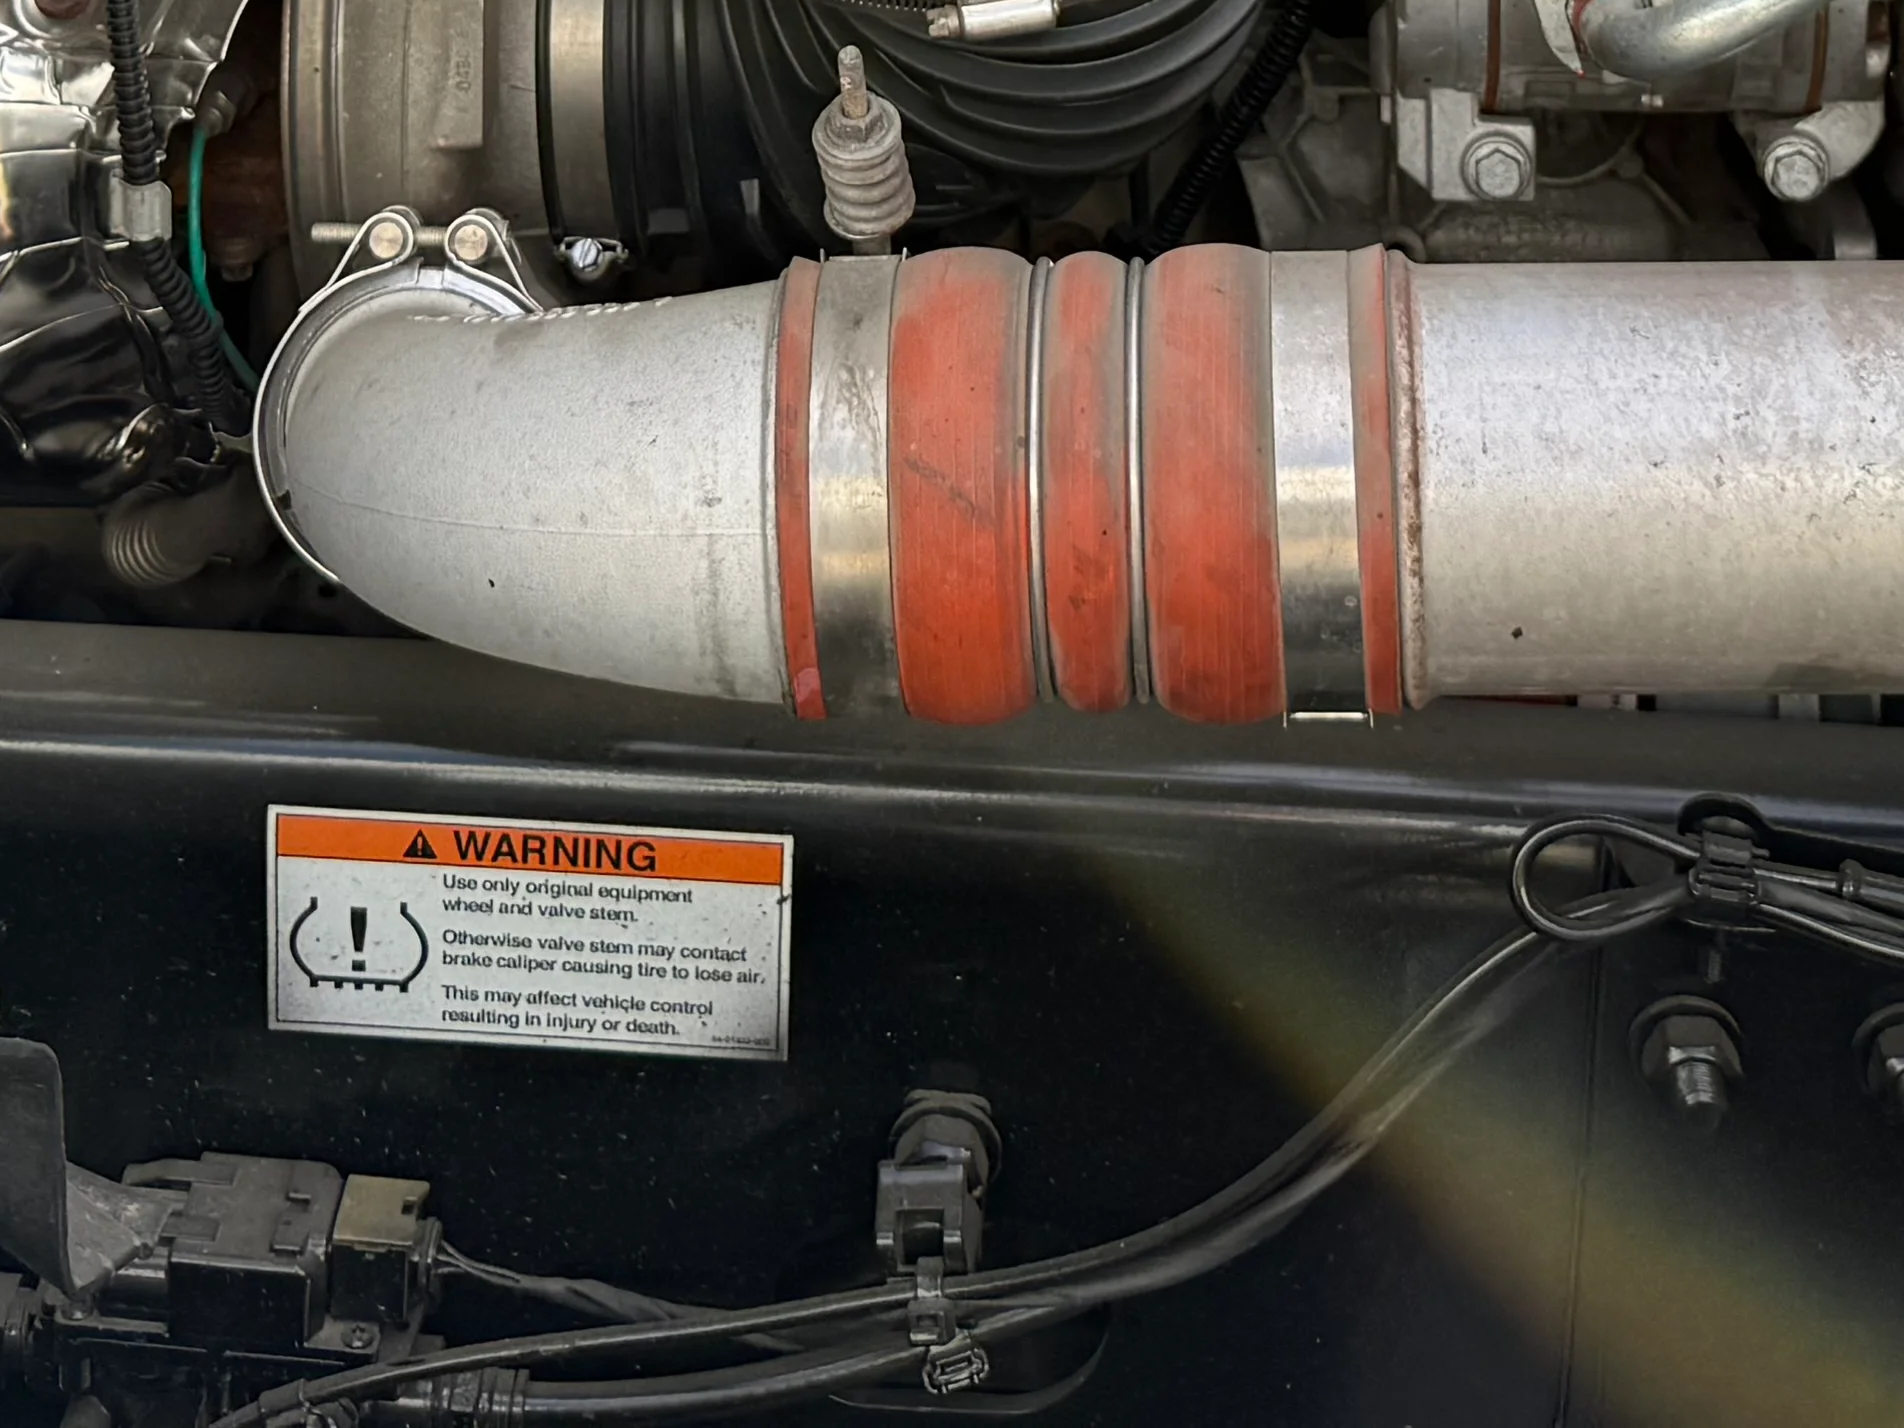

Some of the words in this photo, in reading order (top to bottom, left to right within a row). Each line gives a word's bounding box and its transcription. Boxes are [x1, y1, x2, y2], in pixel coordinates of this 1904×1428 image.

[455, 830, 657, 872] WARNING
[442, 874, 478, 892] Use
[482, 877, 520, 896] only
[525, 879, 593, 899] original
[598, 885, 693, 904] equipment
[442, 898, 493, 916] wheel
[498, 901, 532, 916] and
[538, 903, 585, 919] valve
[589, 906, 639, 922] stem.
[442, 929, 532, 949] Otherwise
[537, 937, 585, 951] valve
[589, 939, 634, 954] stem
[638, 945, 675, 961] may
[680, 946, 748, 963] contact
[442, 952, 492, 968] brake
[496, 955, 558, 973] caliper
[562, 960, 633, 979] causing
[637, 963, 667, 978] tire
[671, 965, 690, 980] to
[695, 966, 733, 982] lose
[442, 984, 478, 1003] This
[484, 991, 522, 1006] may
[526, 990, 577, 1006] affect
[581, 994, 646, 1012] vehicle
[650, 999, 714, 1016] control
[442, 1008, 520, 1030] resulting
[525, 1011, 542, 1026] in
[546, 1011, 597, 1033] injury
[602, 1017, 621, 1031] or
[625, 1019, 681, 1036] death.
